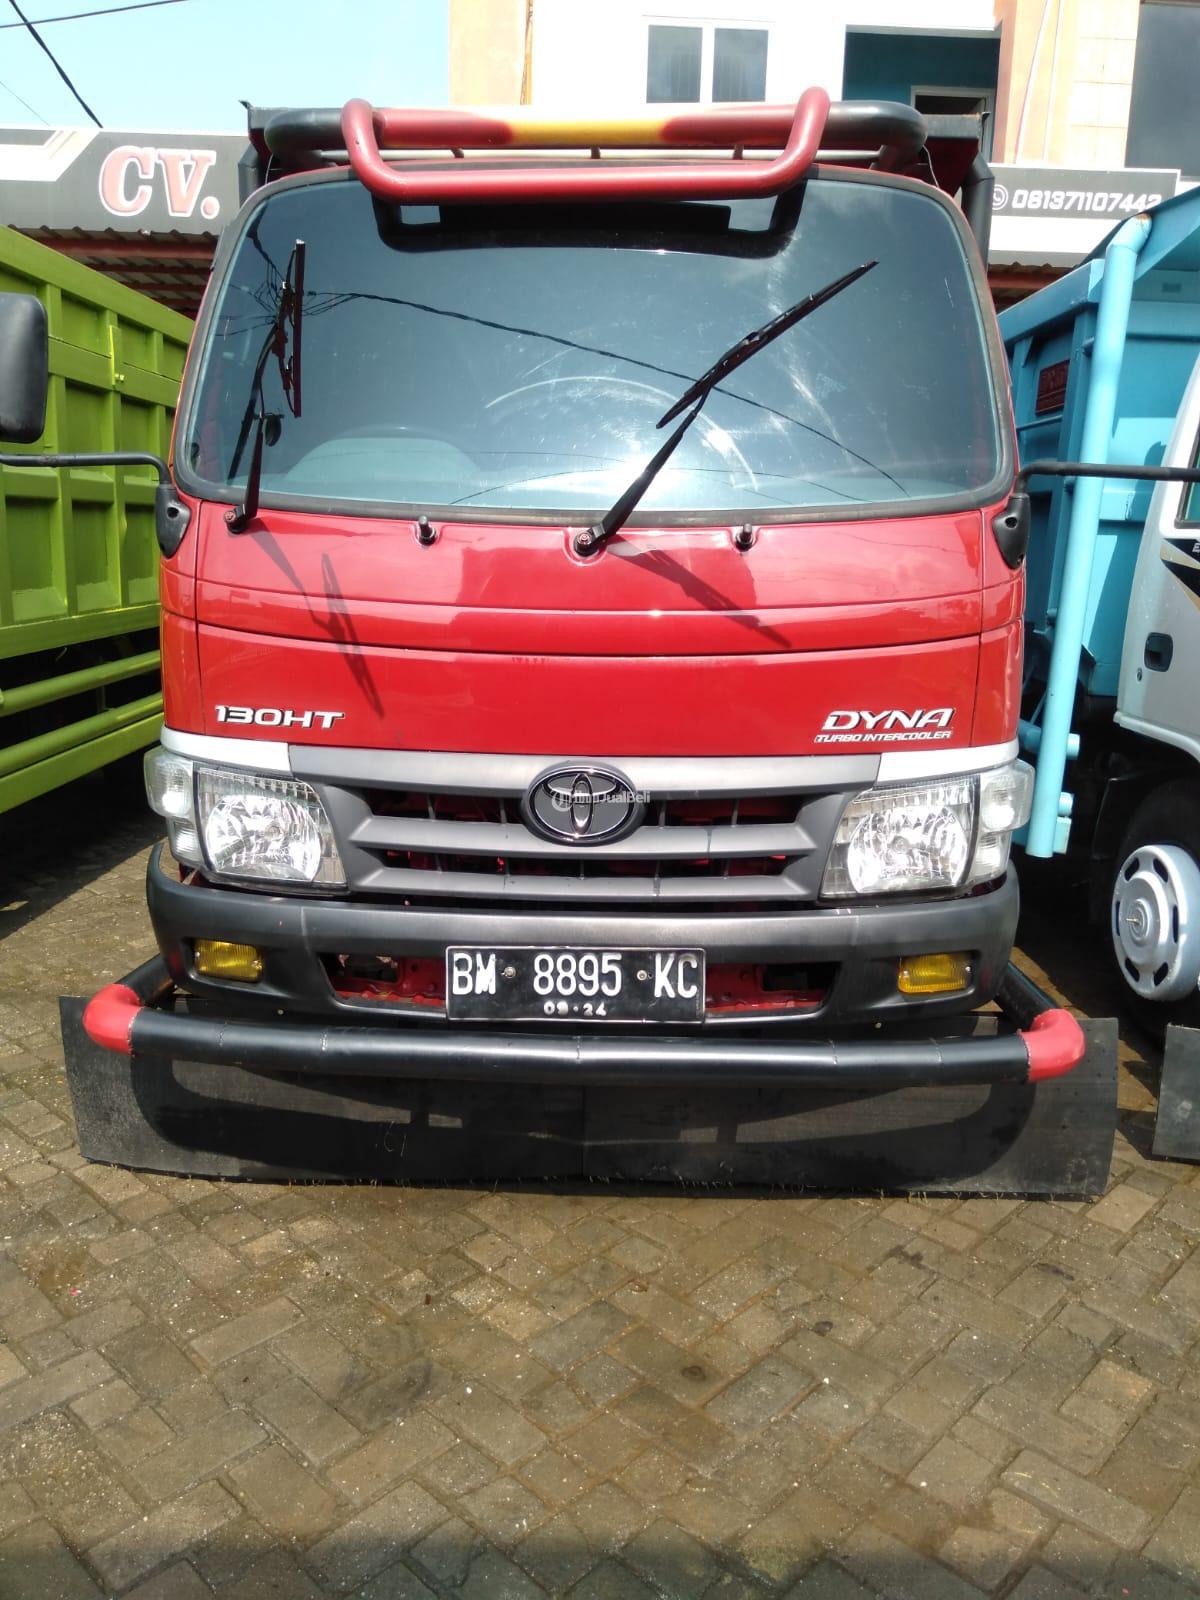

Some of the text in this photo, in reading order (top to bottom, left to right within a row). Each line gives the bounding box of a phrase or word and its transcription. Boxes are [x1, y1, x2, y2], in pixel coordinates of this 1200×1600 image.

[99, 145, 220, 219] CV.
[215, 705, 345, 728] 130HT
[822, 708, 955, 730] DYNA
[814, 731, 952, 743] TURBO INTERCOOLER
[452, 953, 698, 999] BM 8895 KC
